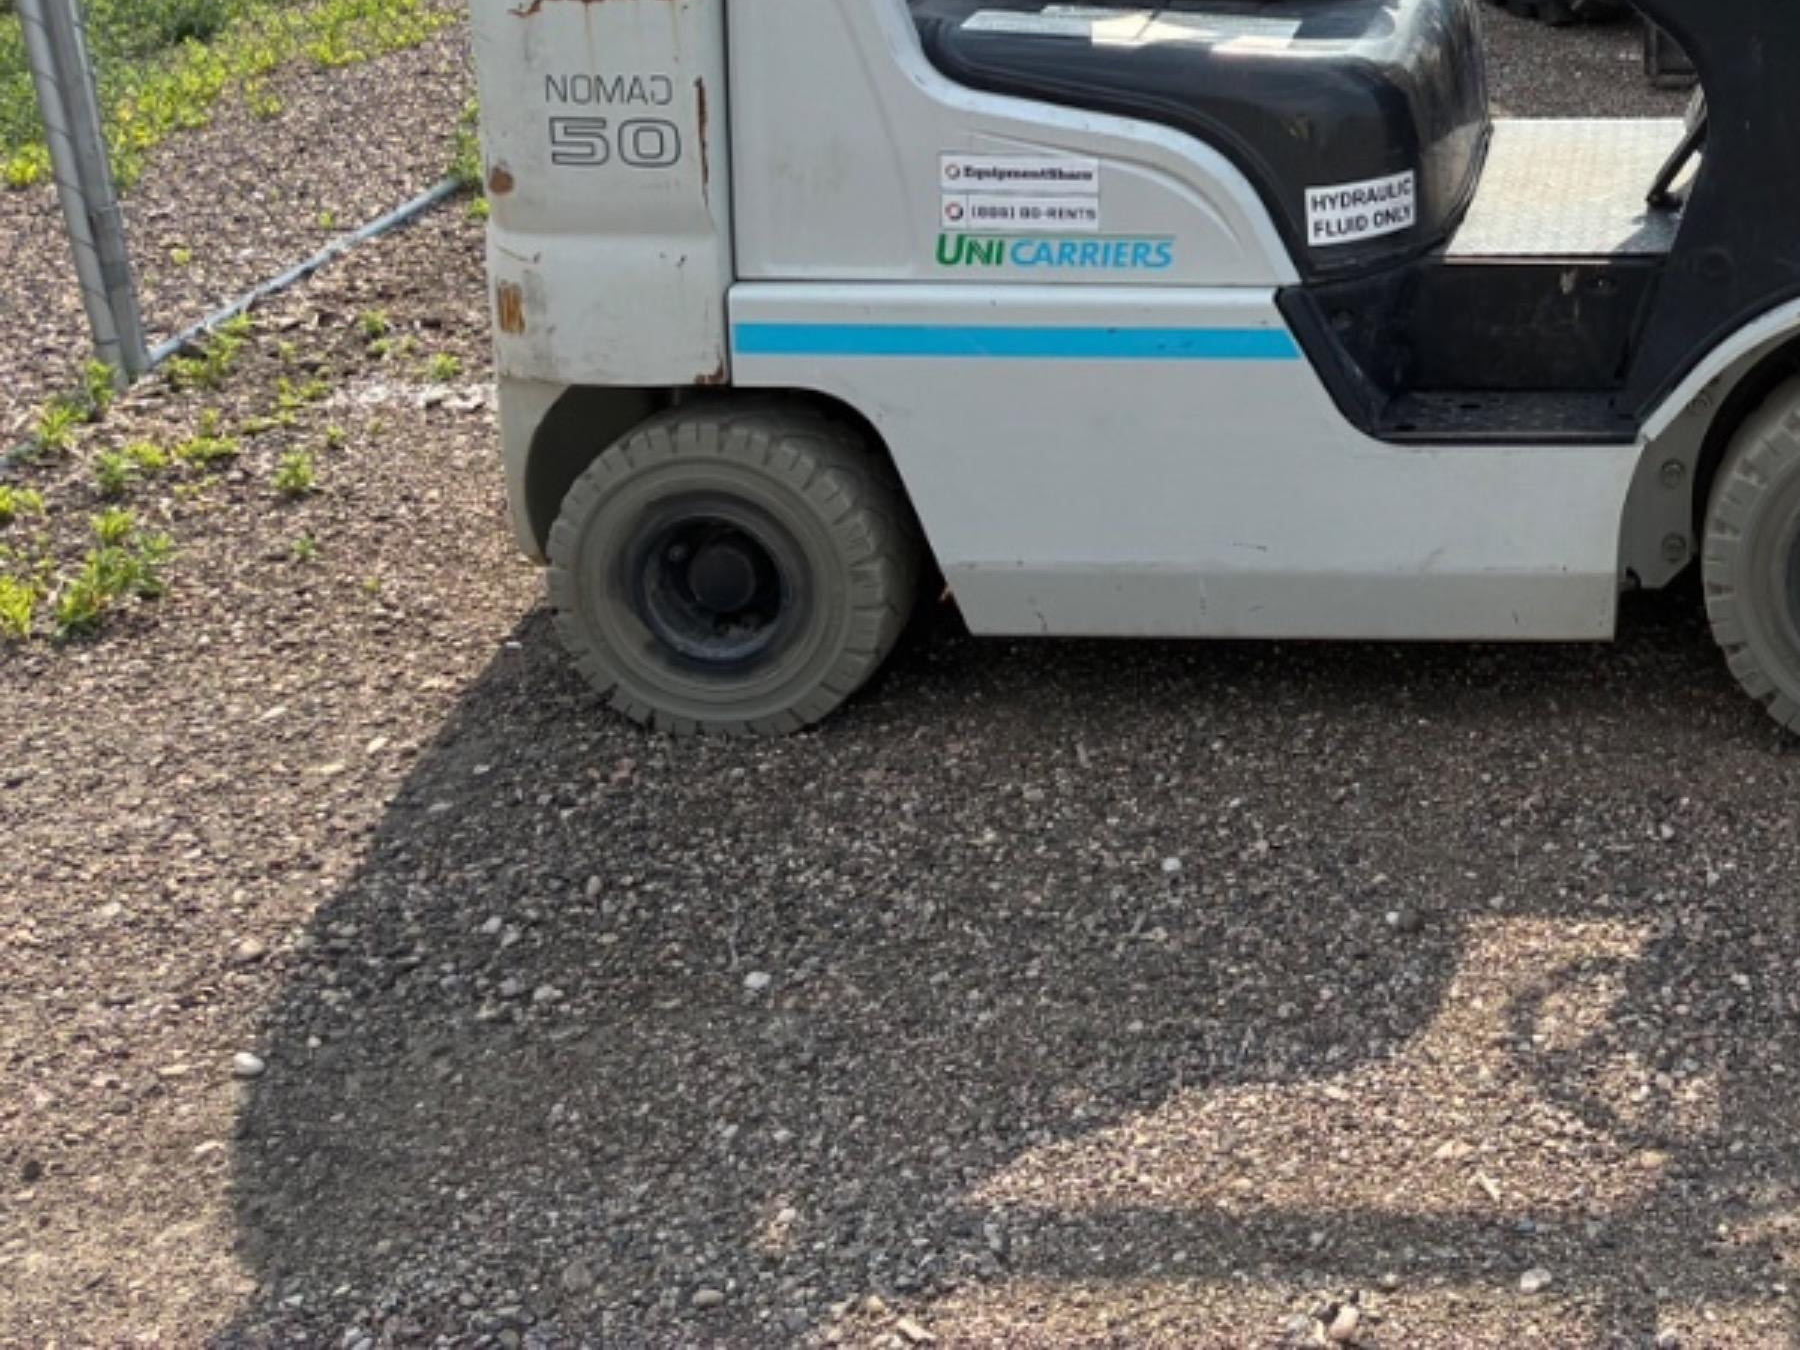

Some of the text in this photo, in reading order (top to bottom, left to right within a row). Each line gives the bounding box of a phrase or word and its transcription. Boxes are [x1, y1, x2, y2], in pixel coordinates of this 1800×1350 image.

[545, 73, 673, 106] NOMAD
[548, 116, 683, 169] 50
[962, 165, 1094, 182] EquipmentShare
[1310, 176, 1414, 212] HYDRAULIC
[1313, 205, 1413, 238] FLUID ONLY
